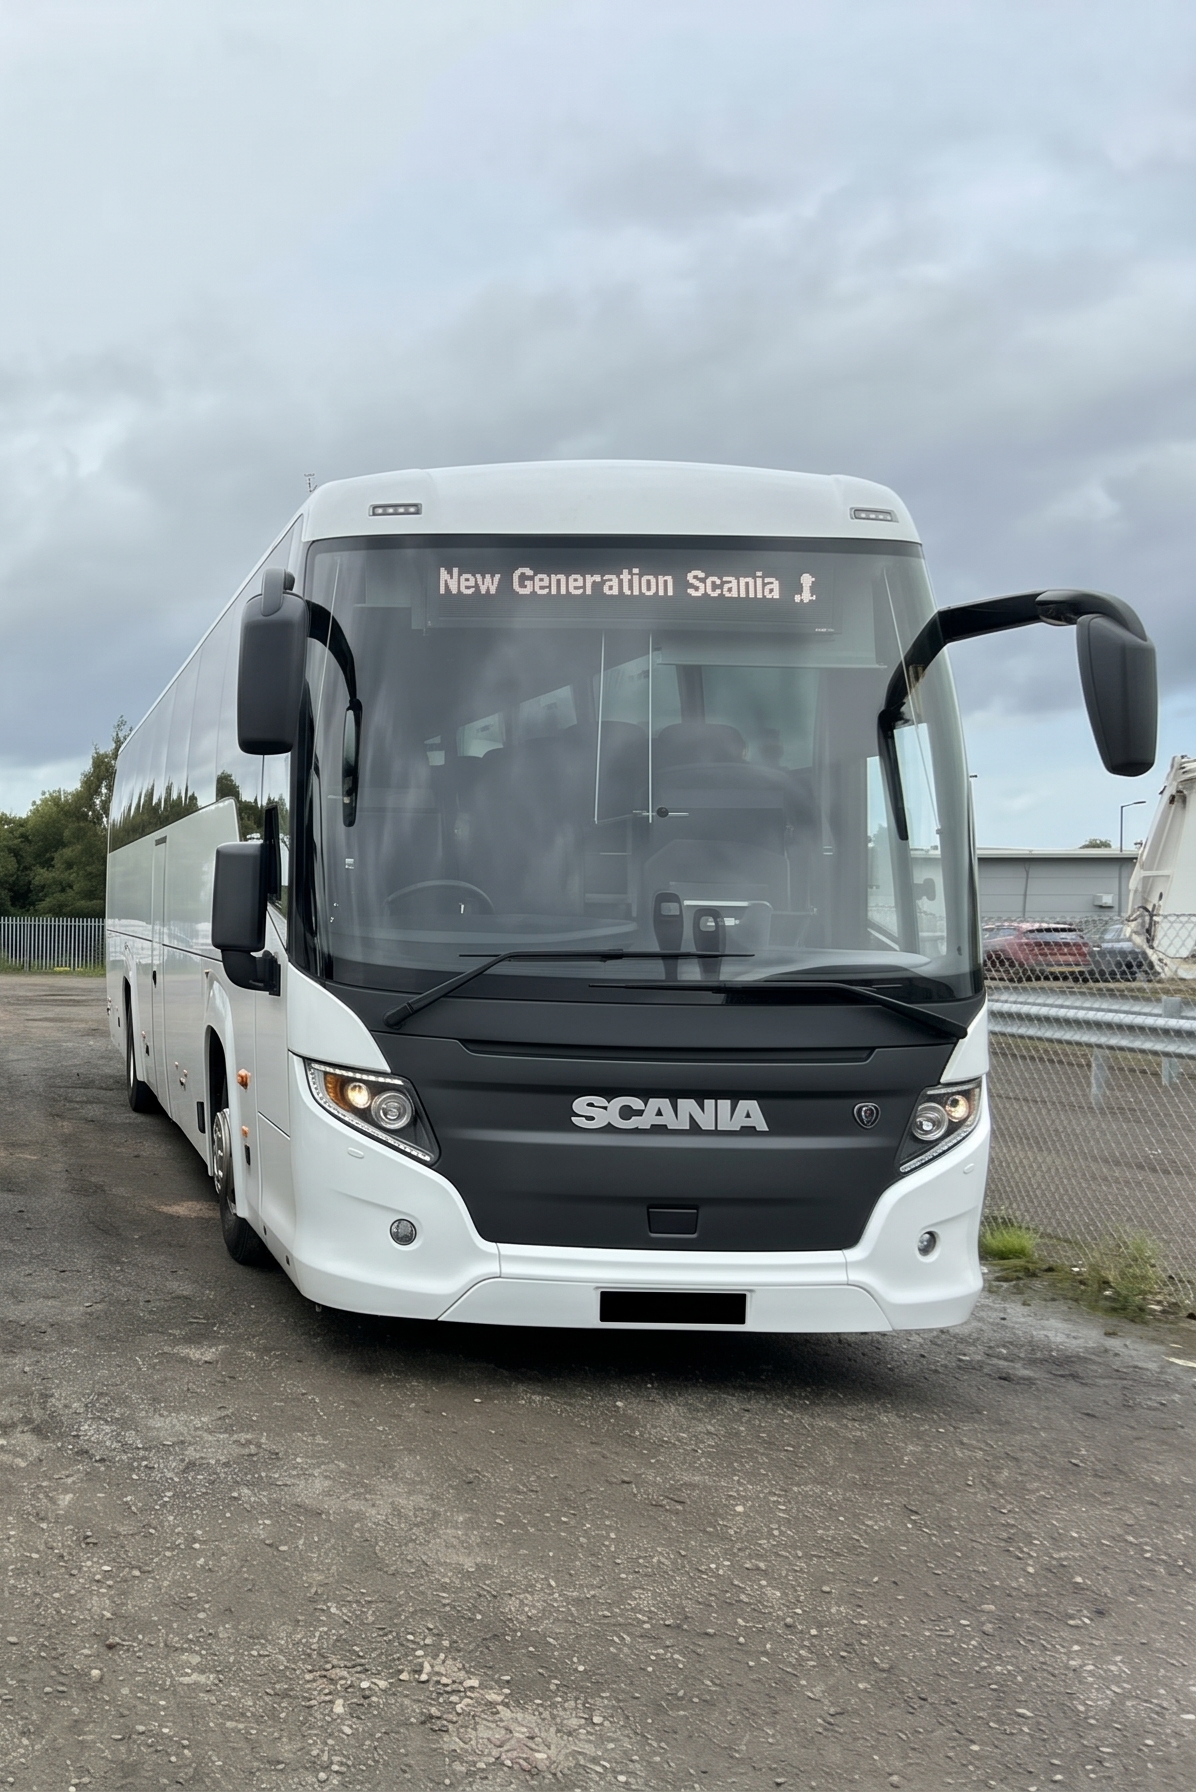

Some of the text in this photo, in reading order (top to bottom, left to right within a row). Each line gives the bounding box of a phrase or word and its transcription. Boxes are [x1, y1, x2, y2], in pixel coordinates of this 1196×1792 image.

[439, 567, 780, 599] New Generation Scania
[571, 1096, 769, 1131] SCANIA
